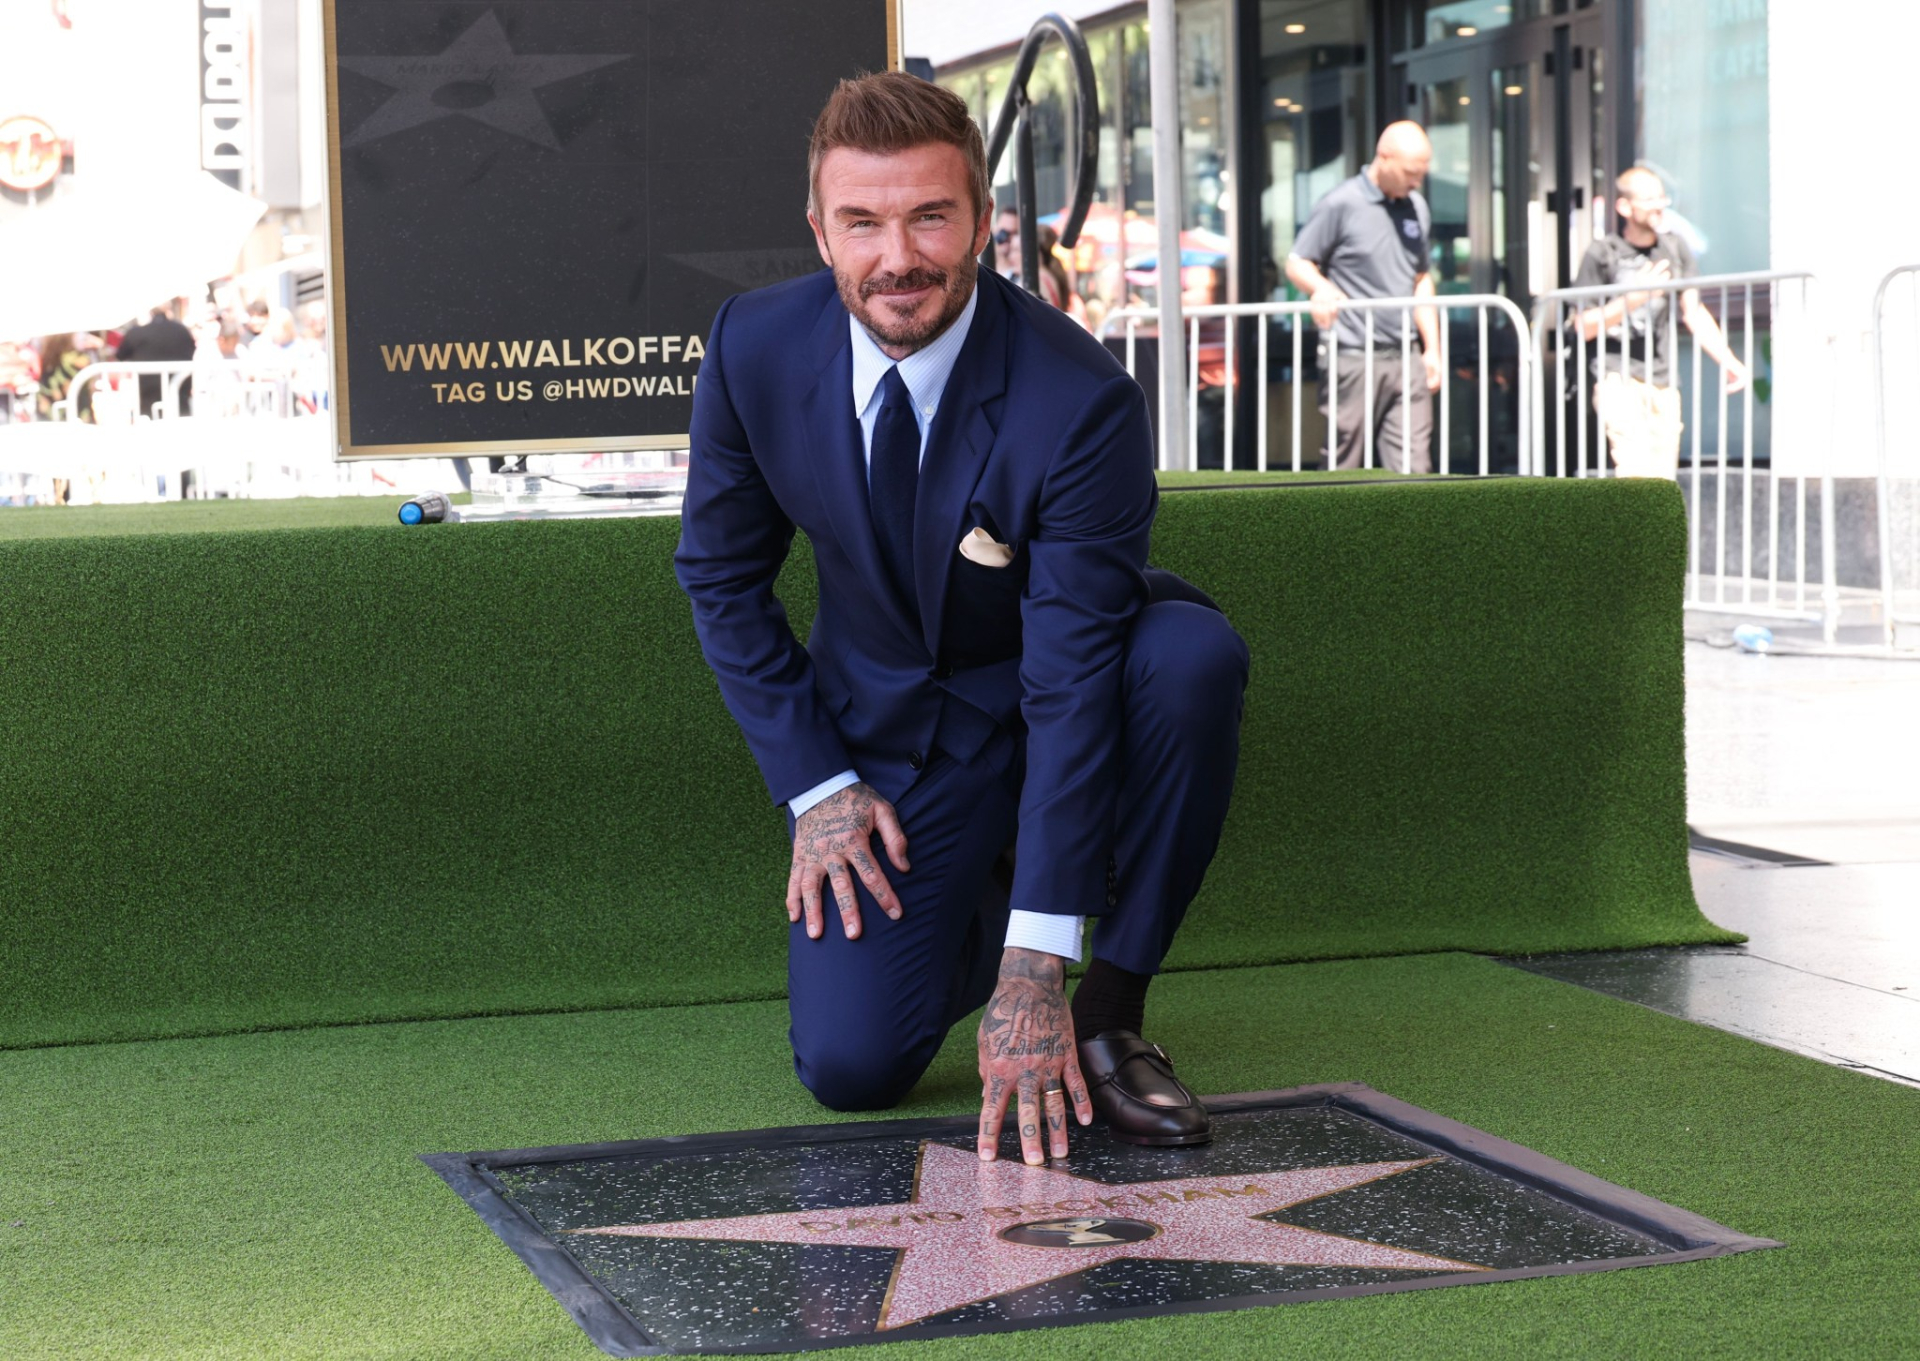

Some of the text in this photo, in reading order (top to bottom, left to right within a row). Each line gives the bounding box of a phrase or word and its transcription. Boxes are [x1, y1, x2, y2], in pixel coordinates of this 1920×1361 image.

[203, 0, 242, 100] DOL
[396, 62, 466, 75] MARIO
[431, 375, 698, 404] TAG US @HWDWAL
[800, 1183, 1271, 1235] DAVID BECKHAM
